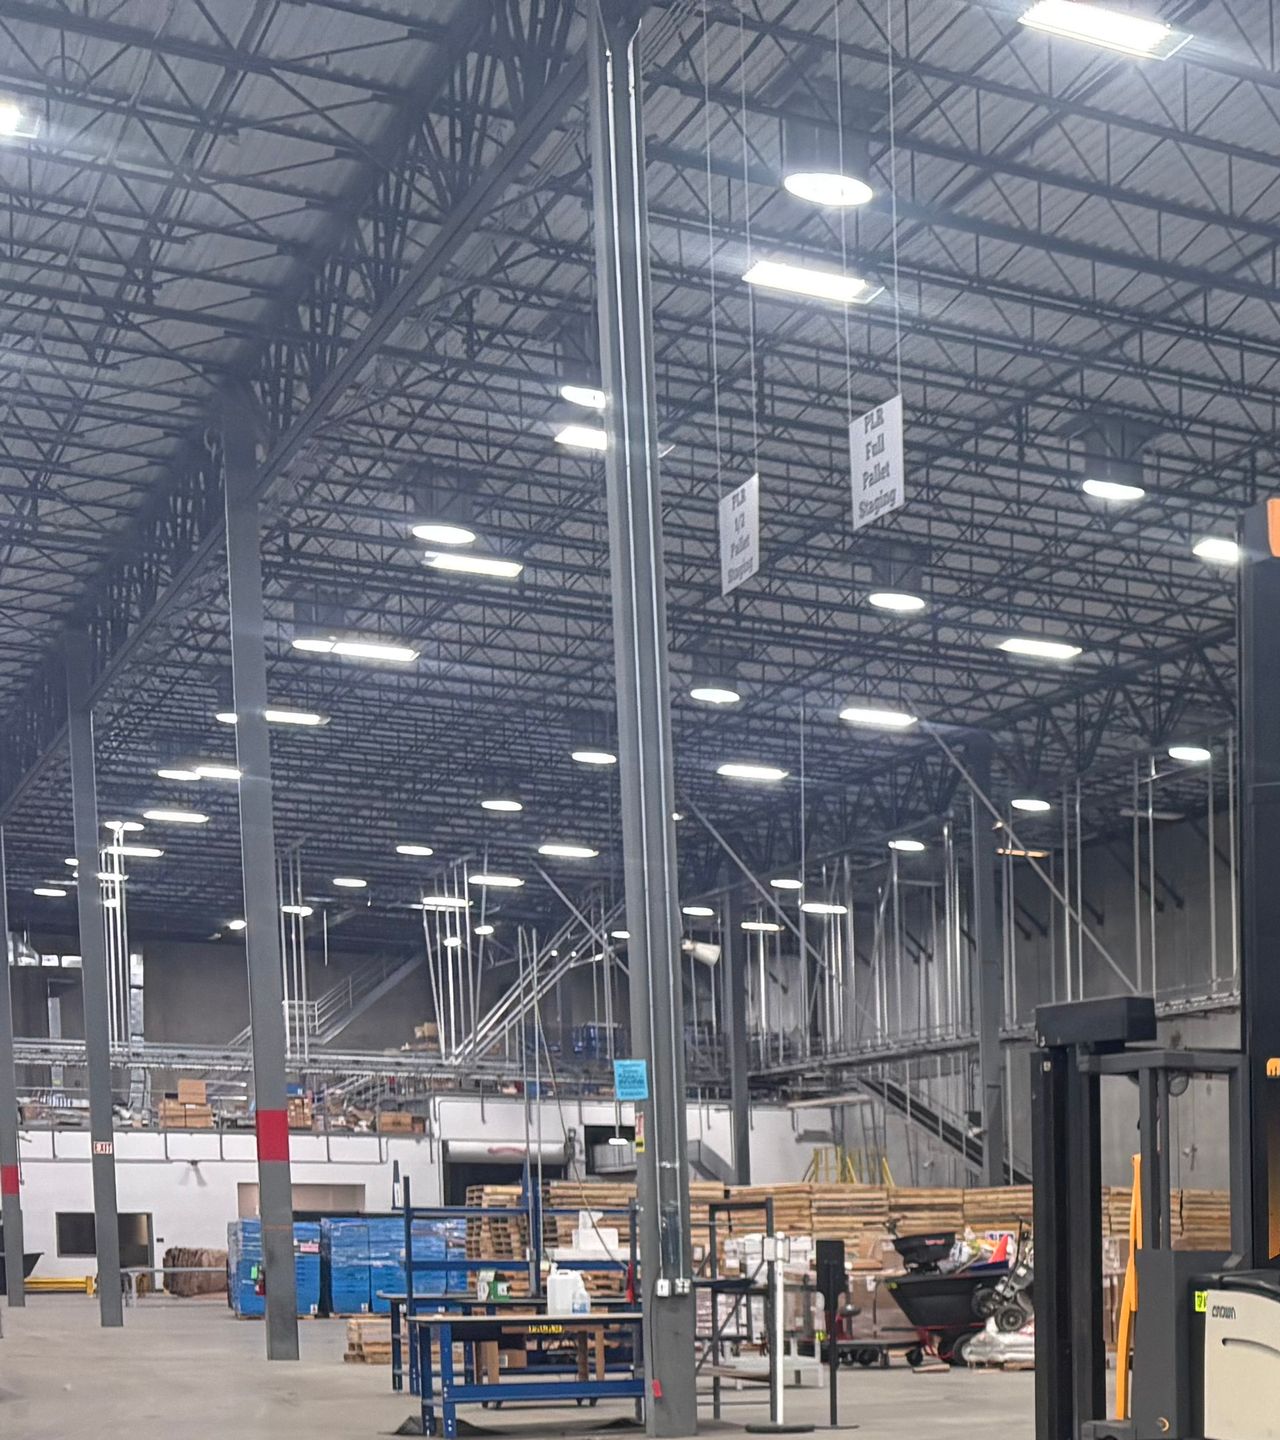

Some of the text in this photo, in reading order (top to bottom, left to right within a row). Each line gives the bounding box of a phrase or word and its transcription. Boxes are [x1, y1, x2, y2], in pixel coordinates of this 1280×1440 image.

[864, 407, 884, 434] PLR
[866, 433, 885, 461] Full
[863, 461, 890, 491] Pallet
[859, 488, 897, 519] Staging
[95, 1142, 111, 1153] EXIT
